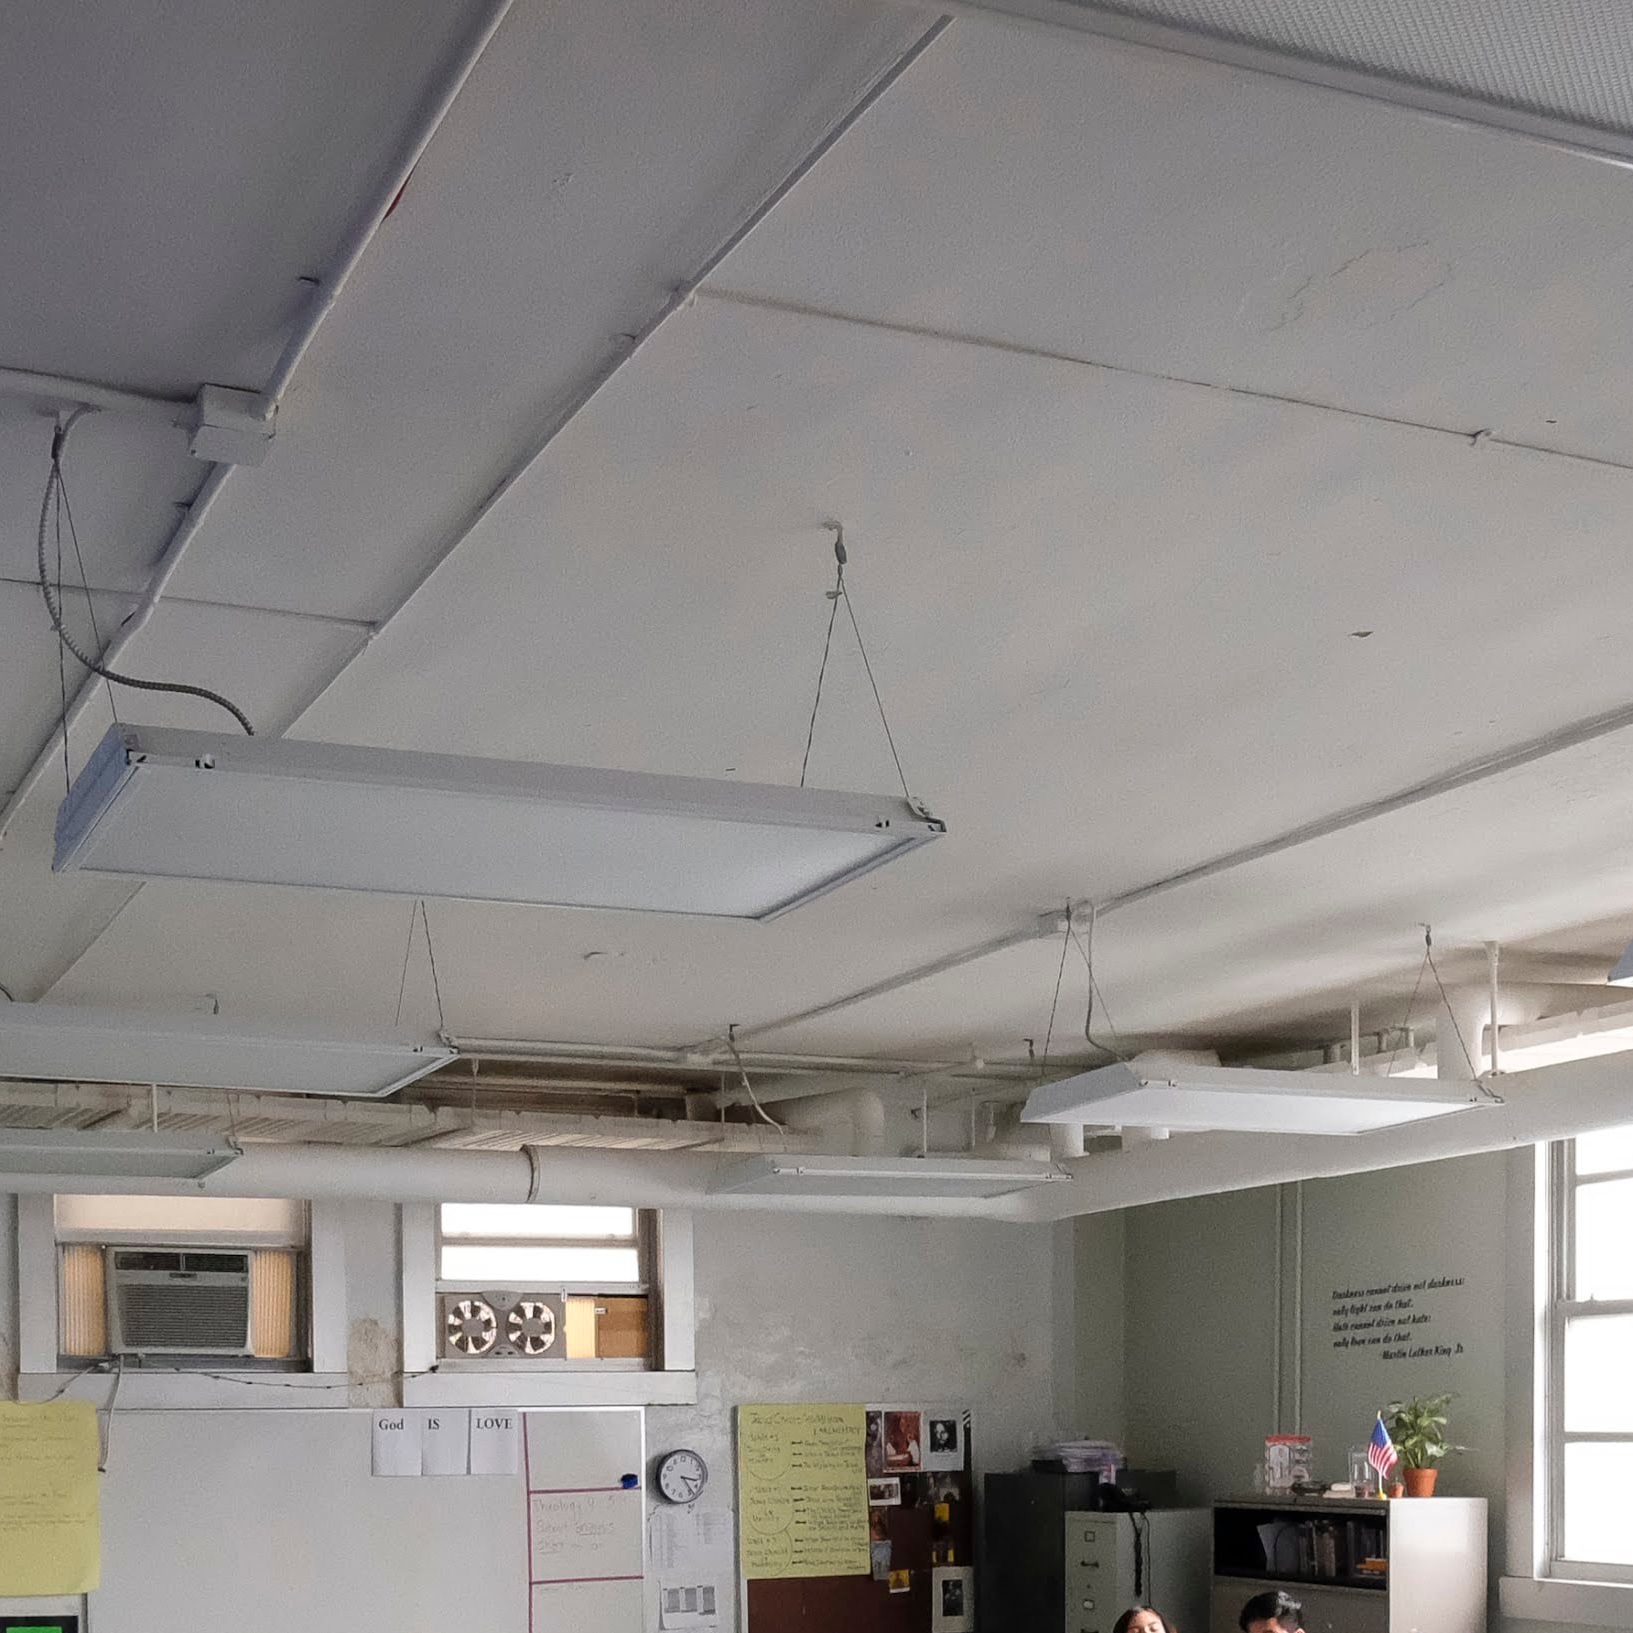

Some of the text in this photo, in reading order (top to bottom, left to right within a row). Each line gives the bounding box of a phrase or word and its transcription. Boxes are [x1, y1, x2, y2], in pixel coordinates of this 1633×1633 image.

[1350, 1302, 1368, 1316] light
[1350, 1319, 1375, 1331] cannot
[1350, 1336, 1366, 1347] love
[1408, 1347, 1433, 1358] Luther
[1434, 1345, 1452, 1357] King
[378, 1418, 513, 1431] God IS LOVE
